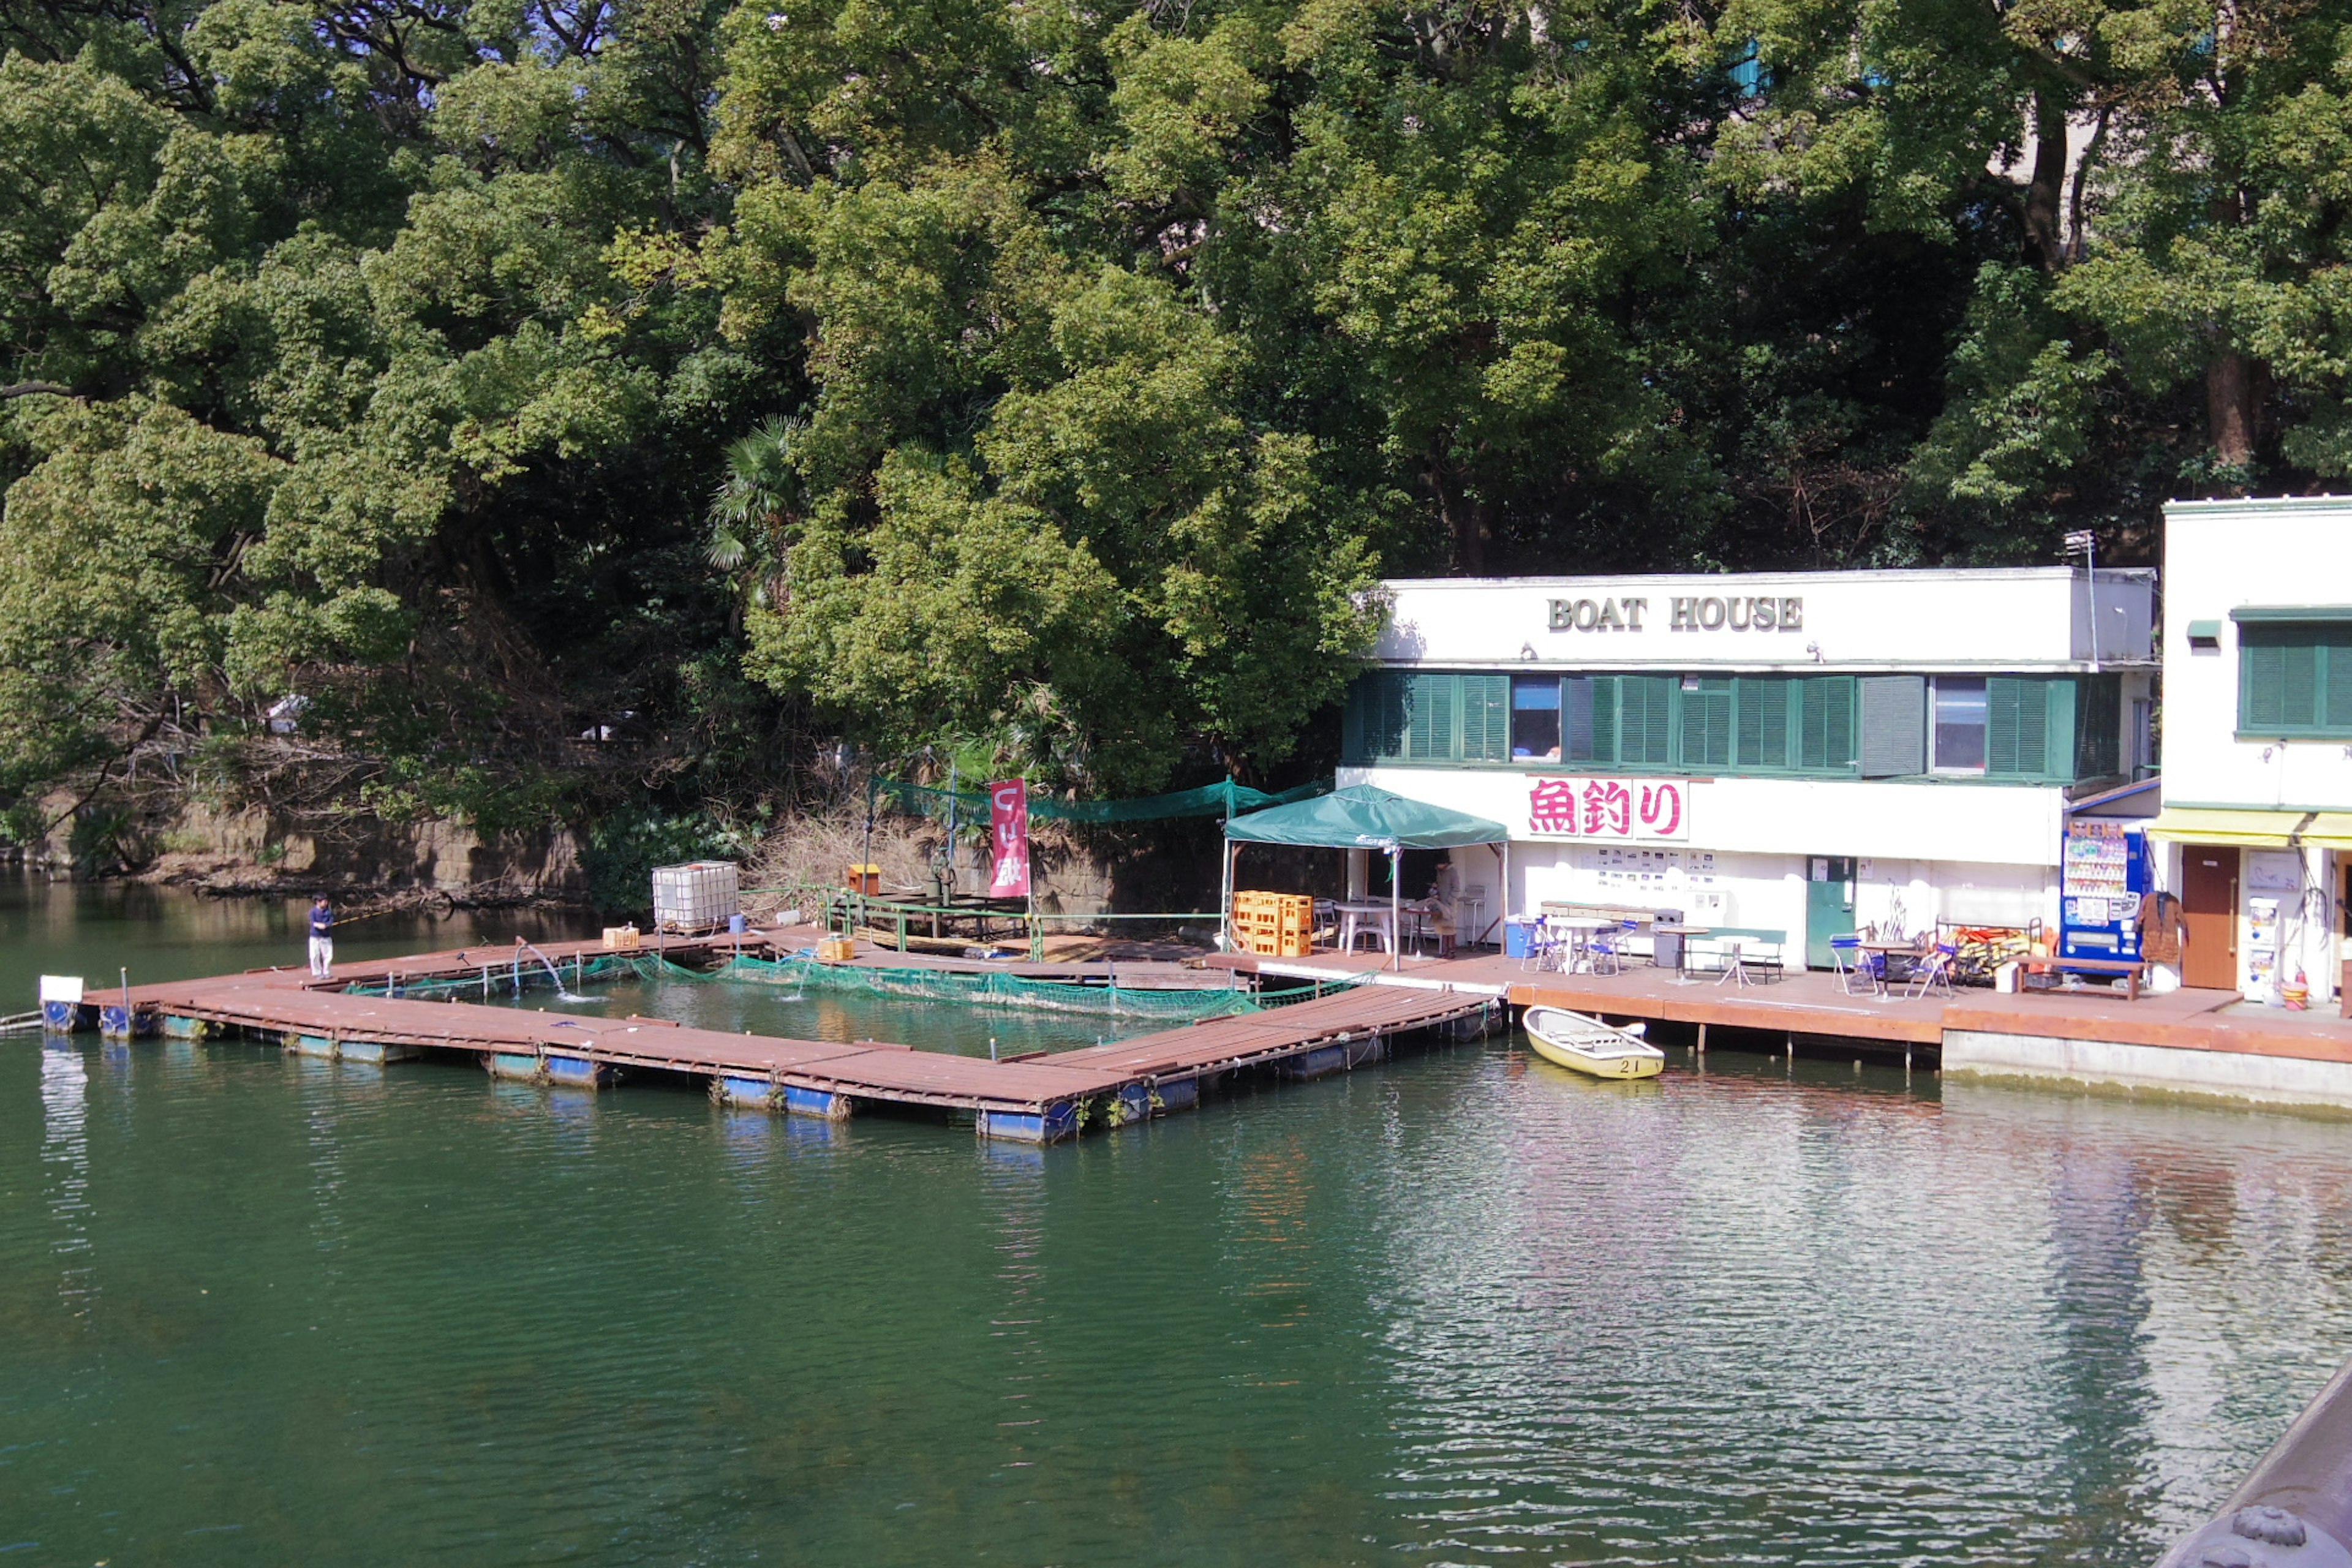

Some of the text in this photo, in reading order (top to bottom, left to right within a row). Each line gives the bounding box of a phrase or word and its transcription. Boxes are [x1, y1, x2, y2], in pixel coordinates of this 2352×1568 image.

[1547, 597, 1803, 630] BOAT HOUSE
[1529, 779, 1680, 834] 魚釣り
[1621, 1059, 1638, 1073] 21
